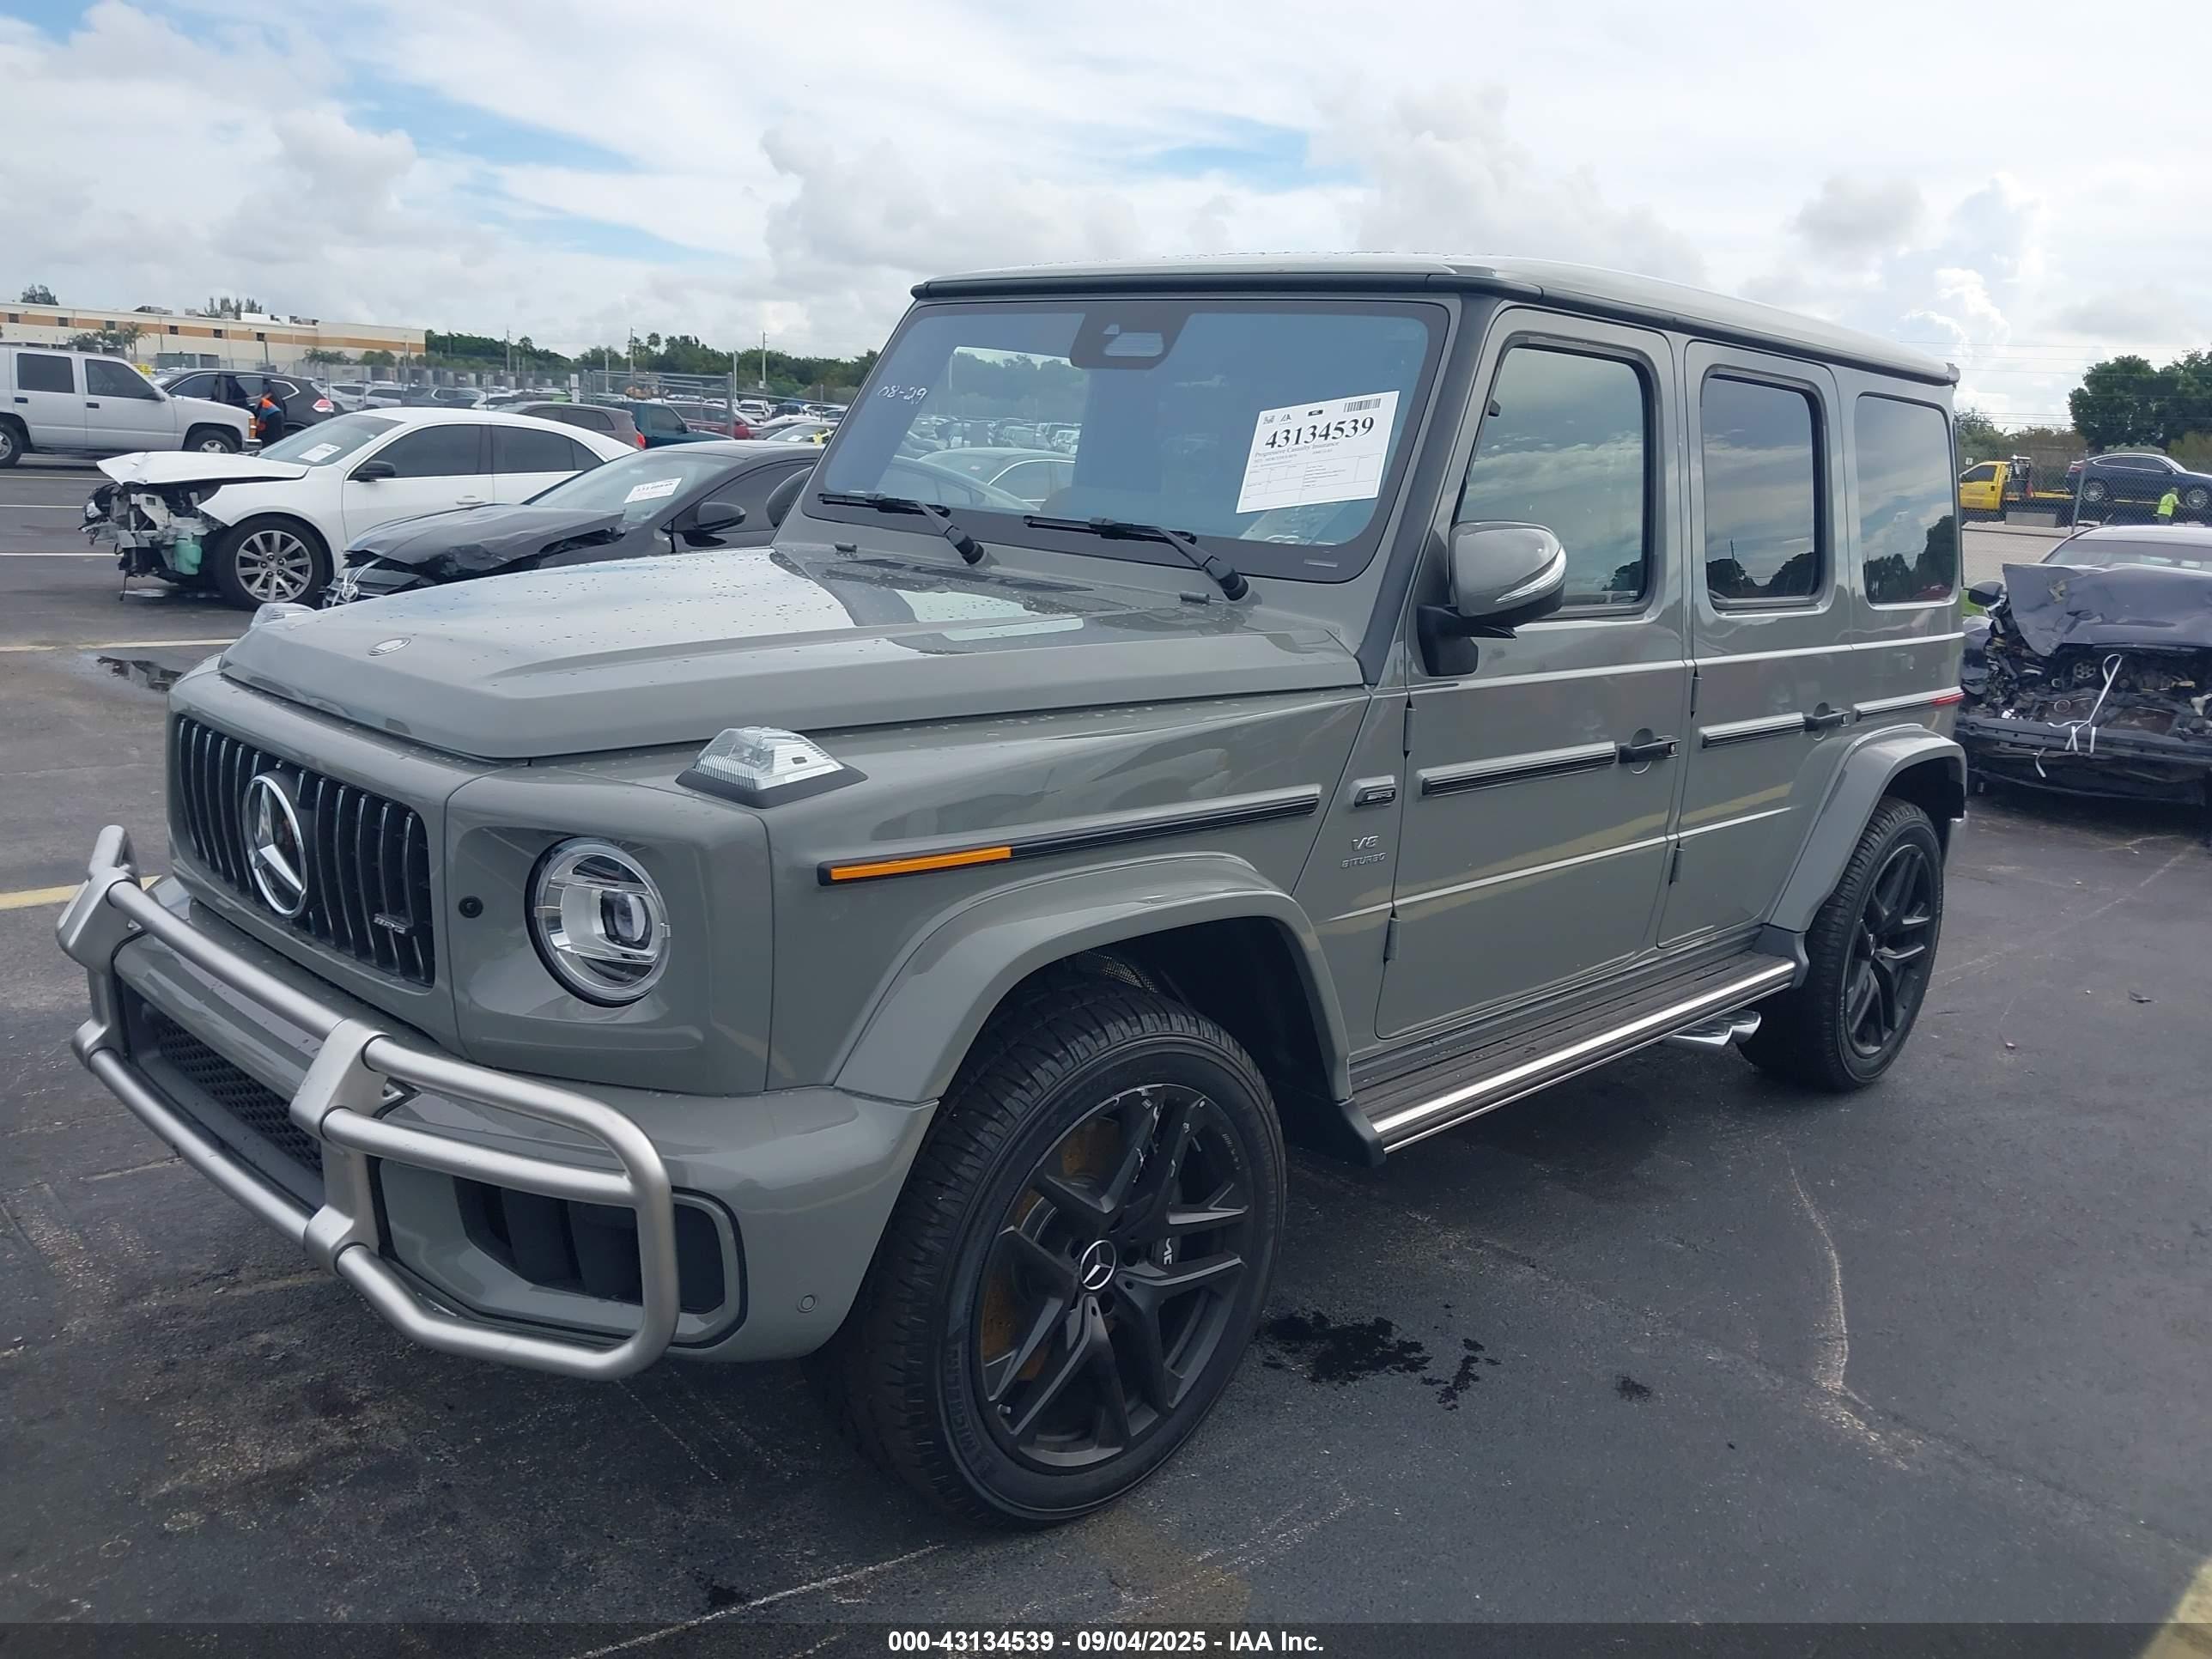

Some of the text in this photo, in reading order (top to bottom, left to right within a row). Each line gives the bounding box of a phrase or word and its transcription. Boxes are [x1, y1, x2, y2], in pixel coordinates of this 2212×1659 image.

[878, 385, 927, 404] 08-29
[1265, 416, 1375, 449] 43134539
[1340, 852, 1387, 869] BITURBO
